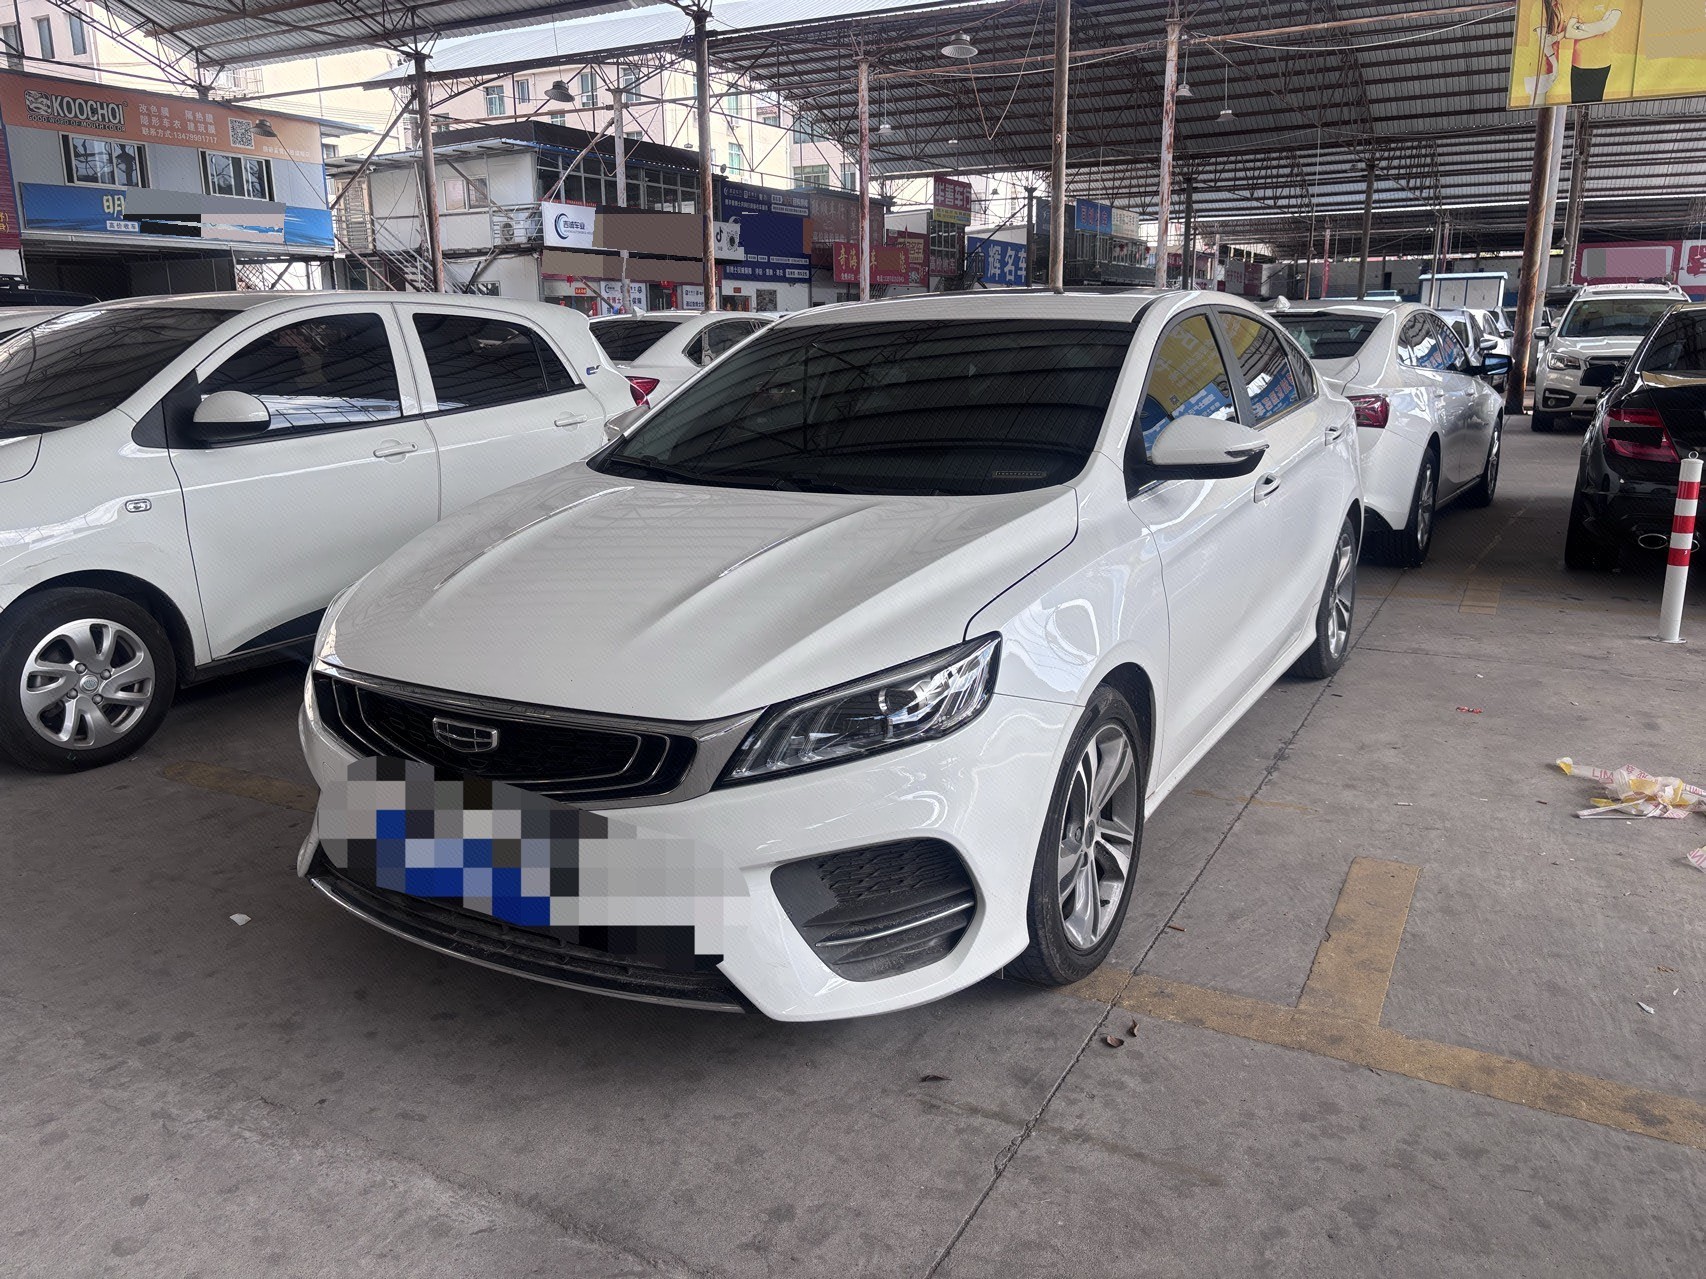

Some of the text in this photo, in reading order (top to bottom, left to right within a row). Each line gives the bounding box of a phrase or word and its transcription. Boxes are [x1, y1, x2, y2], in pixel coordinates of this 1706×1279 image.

[51, 95, 125, 124] KOOCHOI
[28, 114, 47, 122] GOOD
[81, 121, 104, 130] MOUTH
[105, 124, 127, 132] COLOR
